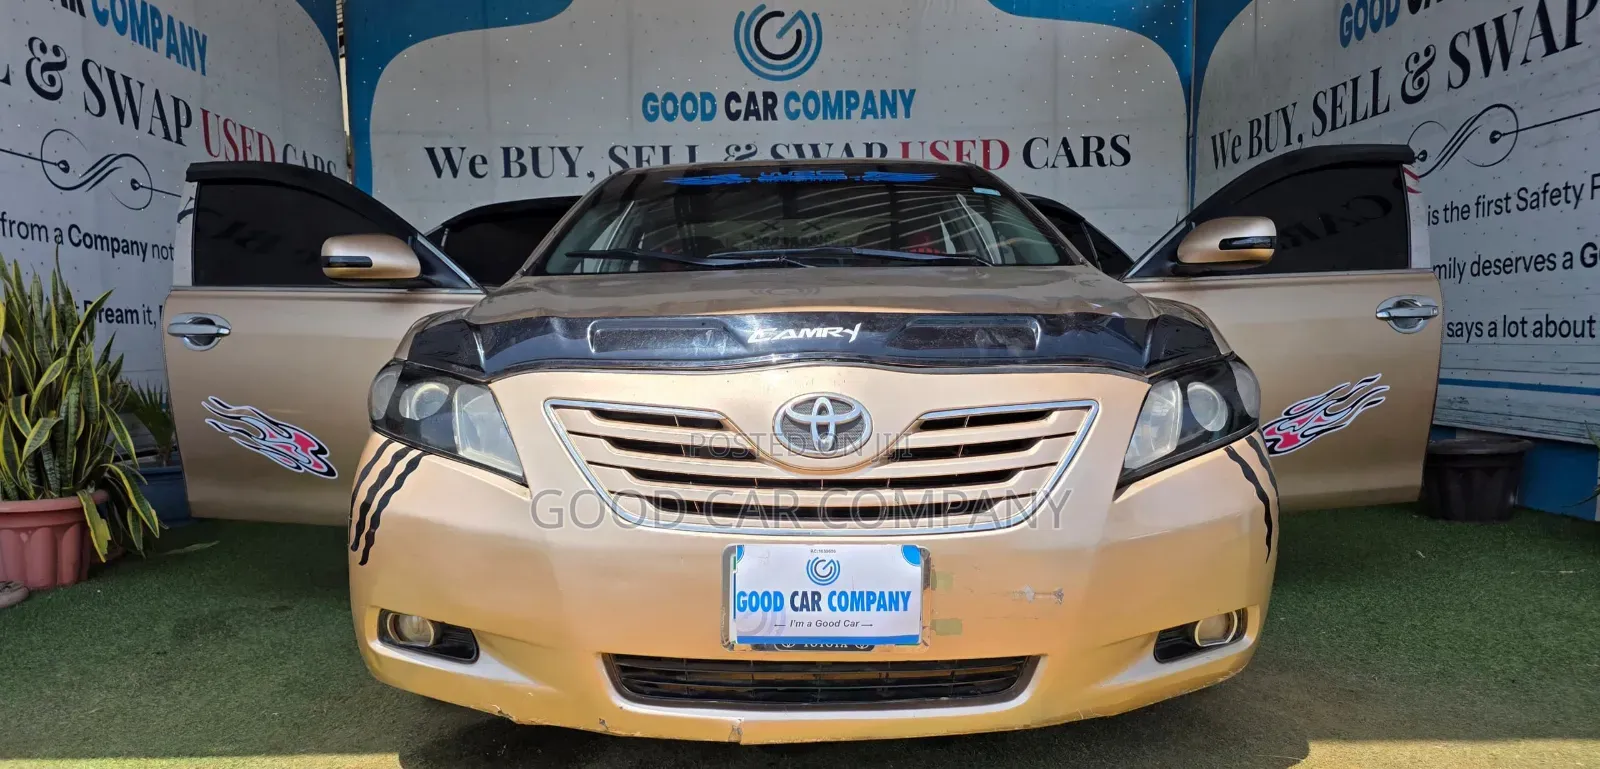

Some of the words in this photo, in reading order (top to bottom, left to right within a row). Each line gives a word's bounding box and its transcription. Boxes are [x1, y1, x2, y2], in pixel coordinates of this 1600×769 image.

[91, 0, 208, 77] COMPANY
[25, 36, 68, 101] &
[81, 58, 193, 147] SWAP
[1211, 128, 1242, 170] We
[1247, 102, 1304, 160] BUY,
[1312, 66, 1391, 139] SELL
[1401, 44, 1437, 105] &
[1447, 0, 1599, 92] SWAP
[641, 91, 718, 123] GOOD
[724, 90, 778, 122] CAR
[783, 88, 917, 121] COMPANY
[424, 145, 489, 180] We
[500, 145, 596, 184] BUY,
[898, 138, 1010, 171] USED
[1022, 134, 1132, 170] CARS
[1427, 204, 1440, 227] is
[1443, 200, 1471, 224] the
[1474, 192, 1512, 219] first
[1516, 181, 1585, 211] Safety
[0, 211, 49, 243] from
[54, 227, 64, 246] a
[68, 223, 148, 263] Company
[151, 243, 174, 261] not
[1470, 254, 1557, 278] deserves
[1561, 251, 1574, 270] a
[142, 303, 157, 329] it,
[1446, 320, 1484, 344] says
[1488, 320, 1498, 338] a
[1503, 314, 1528, 338] lot
[1532, 313, 1597, 338] about
[736, 590, 785, 612] GOOD
[790, 590, 822, 612] CAR
[827, 590, 912, 612] COMPANY
[790, 619, 805, 628] I'm
[815, 619, 841, 628] Good
[844, 619, 860, 628] Car
